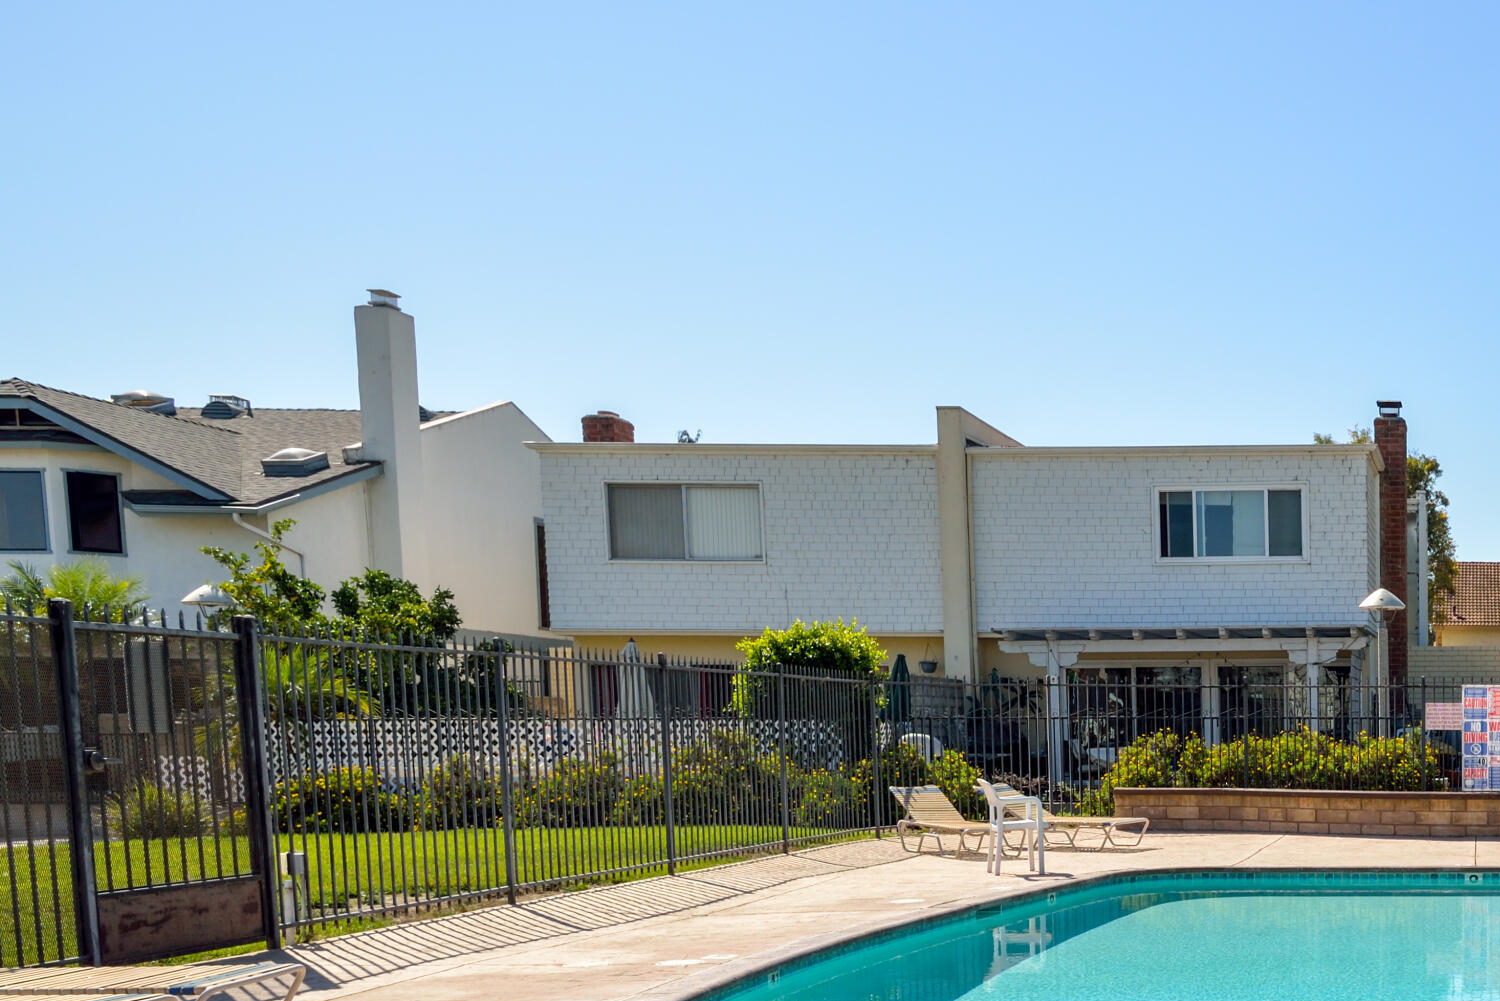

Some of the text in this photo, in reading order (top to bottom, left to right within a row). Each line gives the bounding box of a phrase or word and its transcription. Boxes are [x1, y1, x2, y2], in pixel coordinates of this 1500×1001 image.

[1464, 698, 1488, 708] CAUTION
[1470, 721, 1482, 732] NO
[1464, 732, 1488, 743] DIVING
[1464, 768, 1488, 779] CAPACITY
